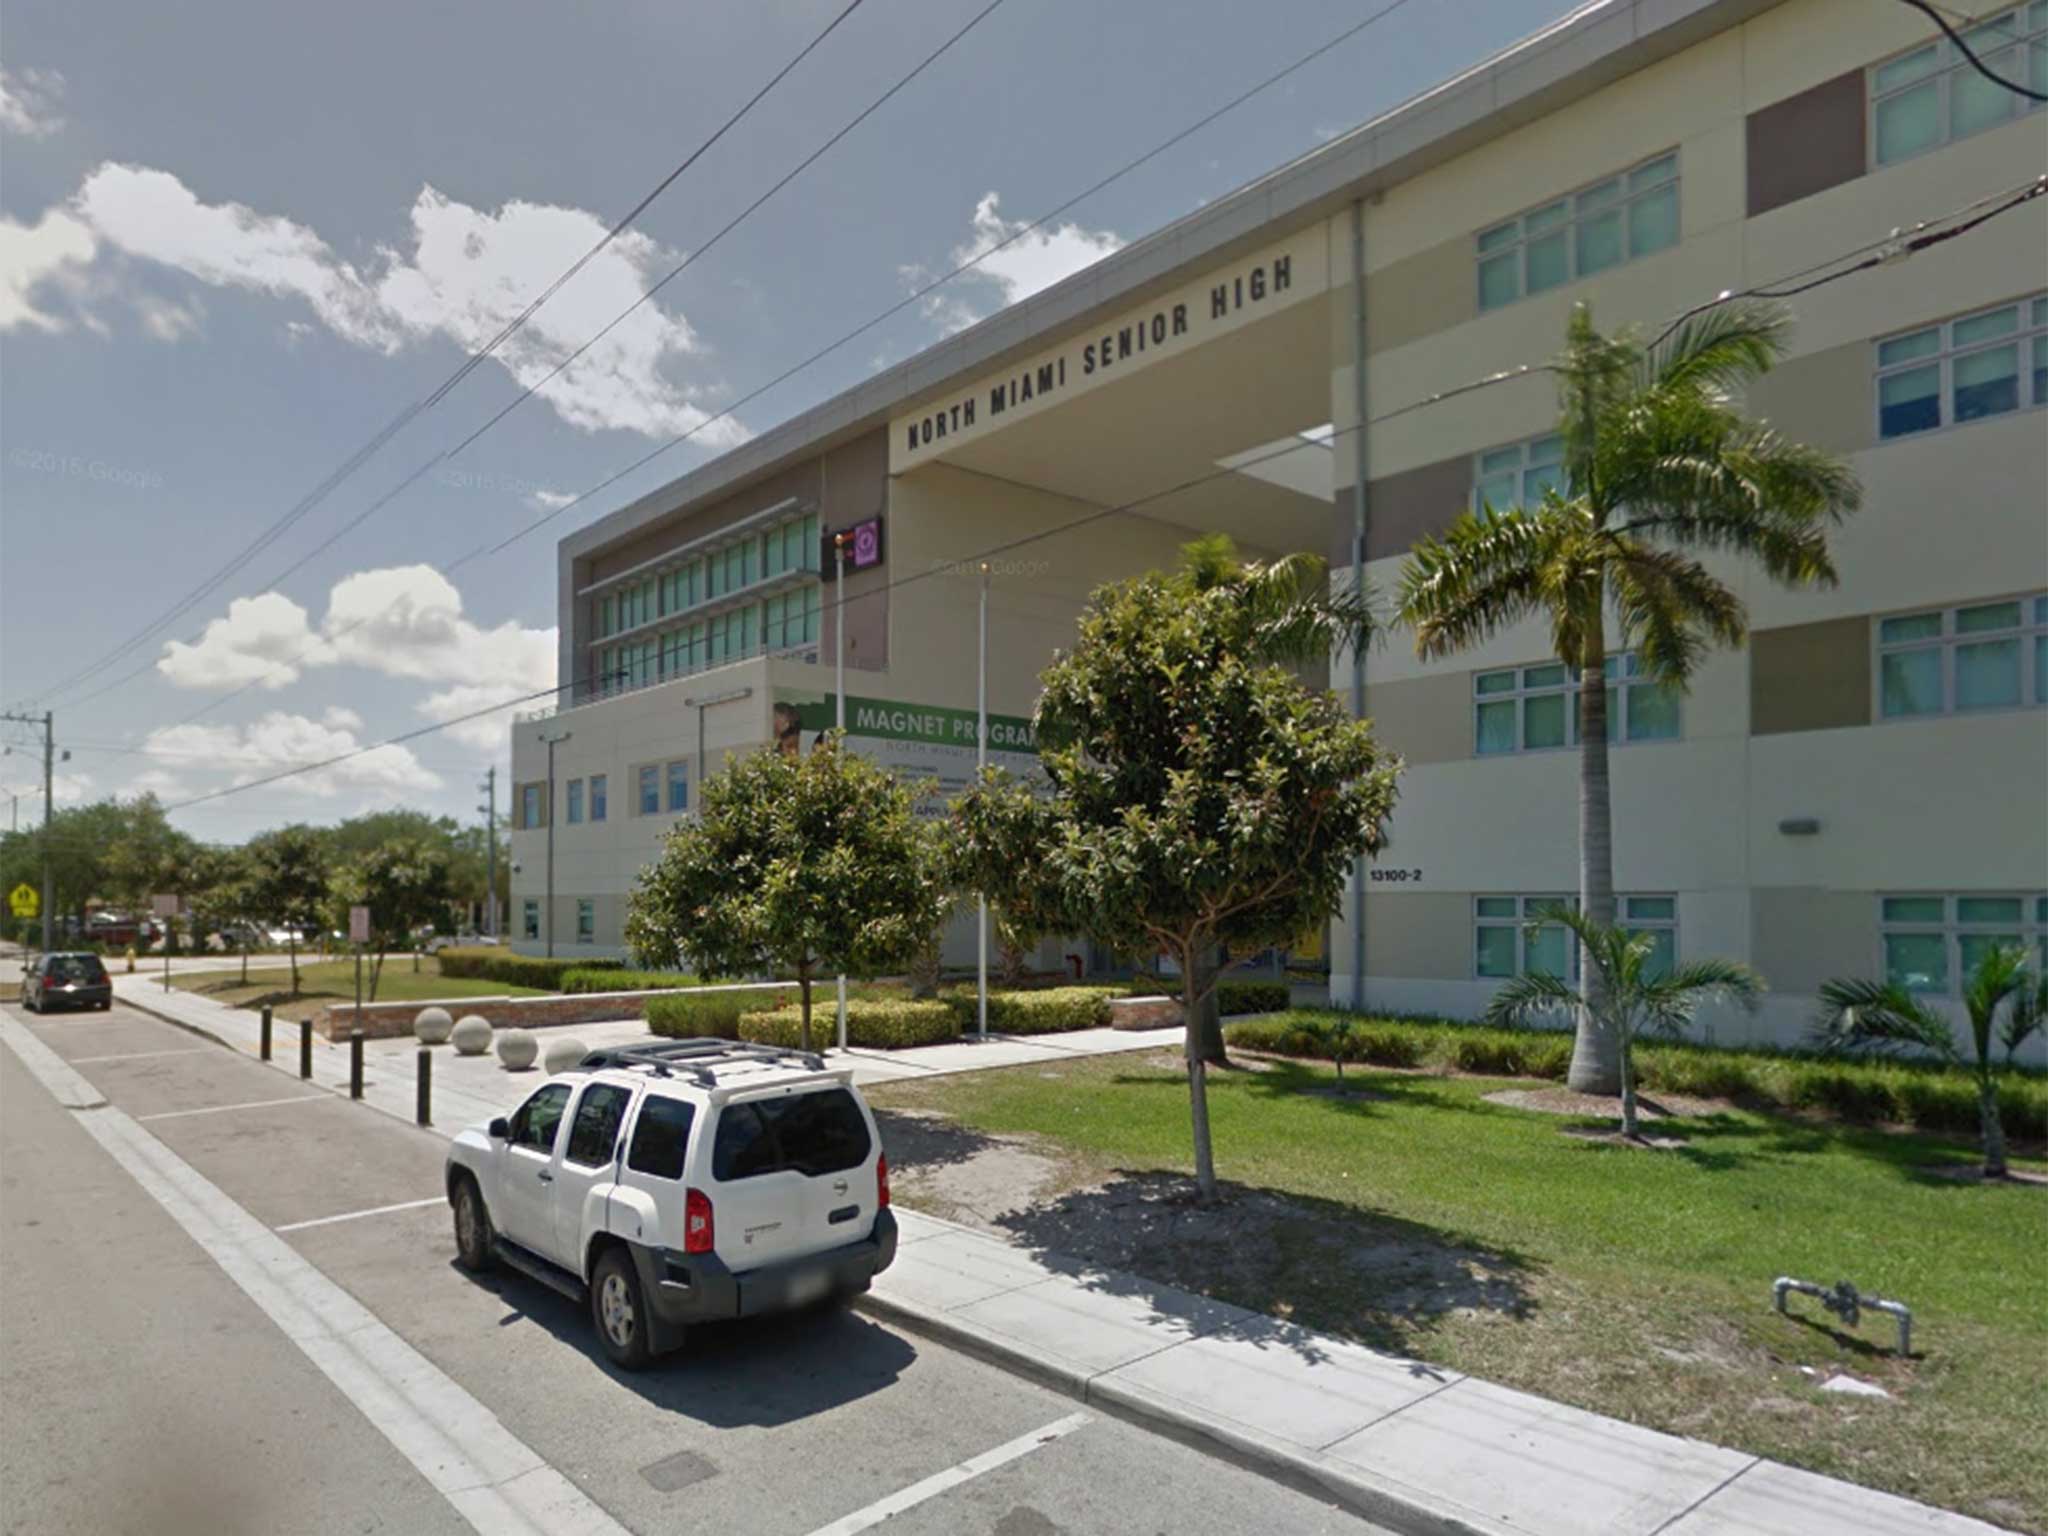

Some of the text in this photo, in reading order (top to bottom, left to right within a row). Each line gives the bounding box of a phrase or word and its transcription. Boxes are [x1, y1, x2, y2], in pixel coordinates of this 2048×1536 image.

[908, 255, 1292, 450] NORTH MIAMI SENIOR HIGH
[857, 707, 945, 736] MAGNET
[1370, 869, 1422, 881] 13100-2
